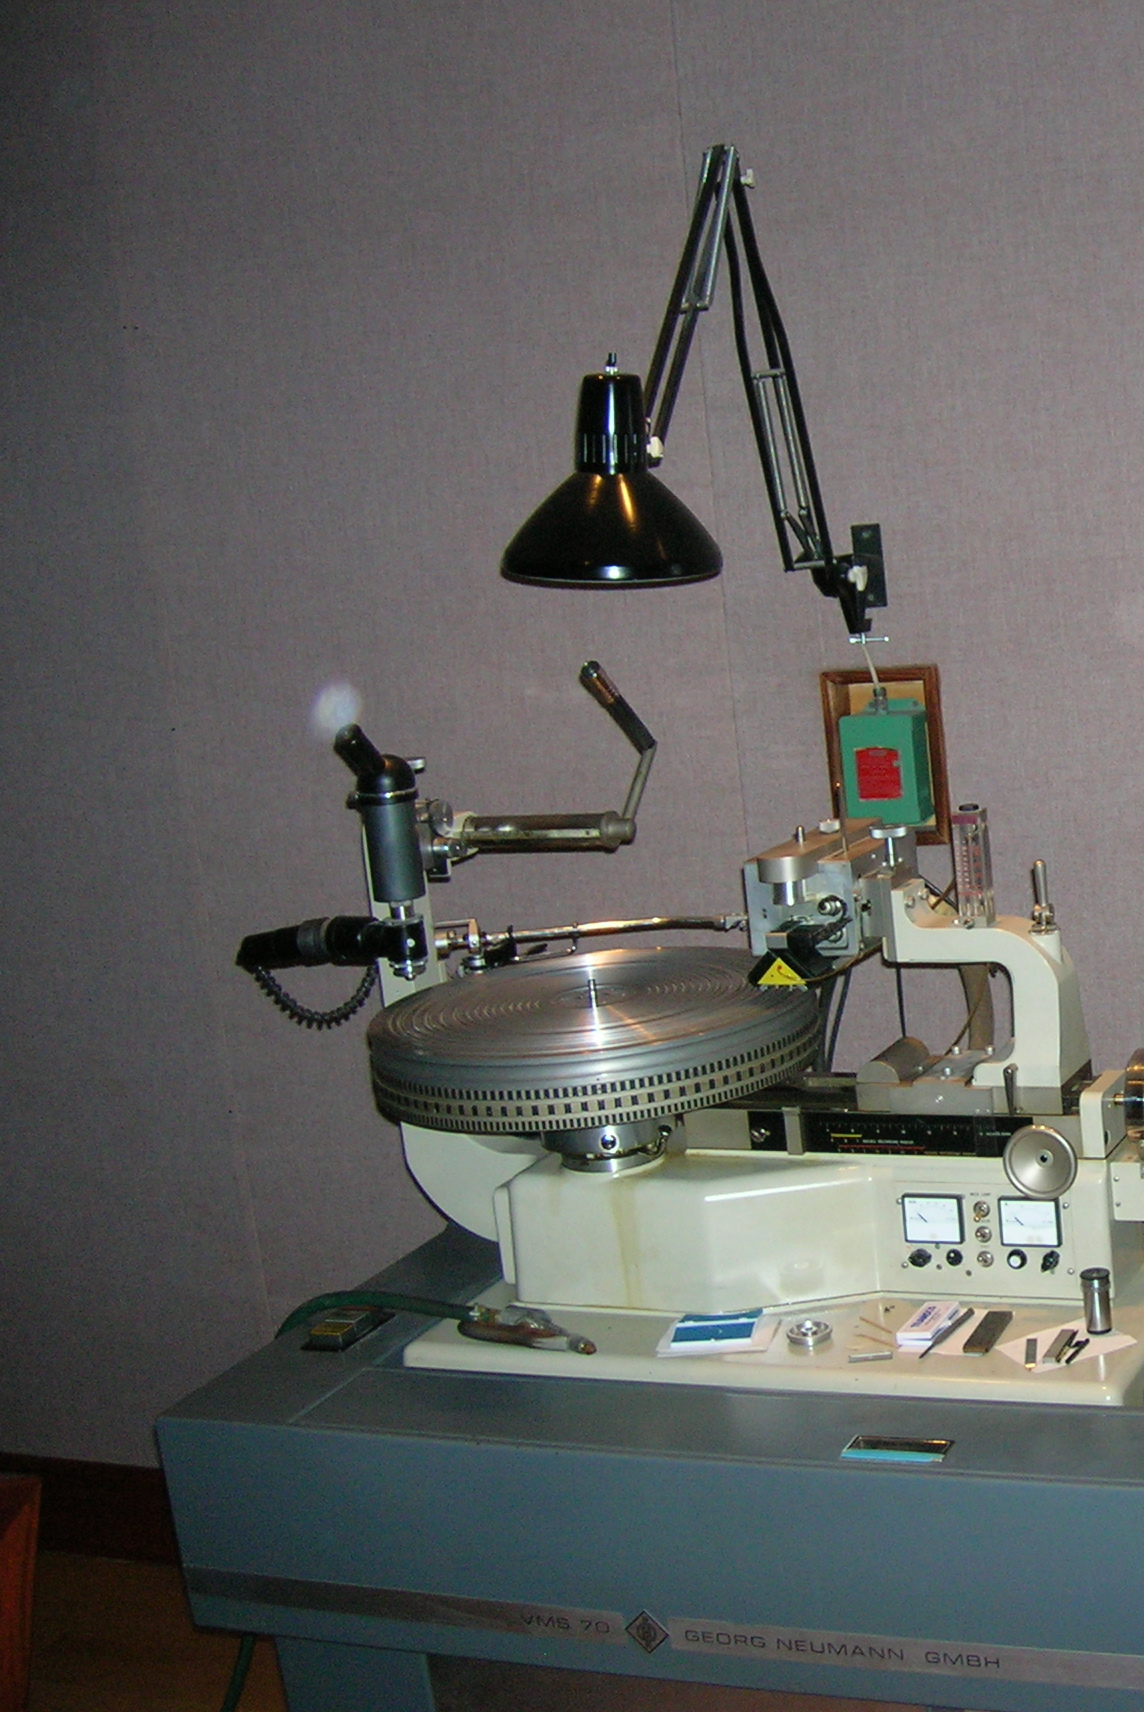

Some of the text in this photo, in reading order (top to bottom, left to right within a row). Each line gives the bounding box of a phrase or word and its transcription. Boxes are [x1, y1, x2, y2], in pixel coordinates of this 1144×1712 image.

[520, 1613, 611, 1634] VMS 70
[684, 1629, 1001, 1669] GEORG NEUMANN GMBH
